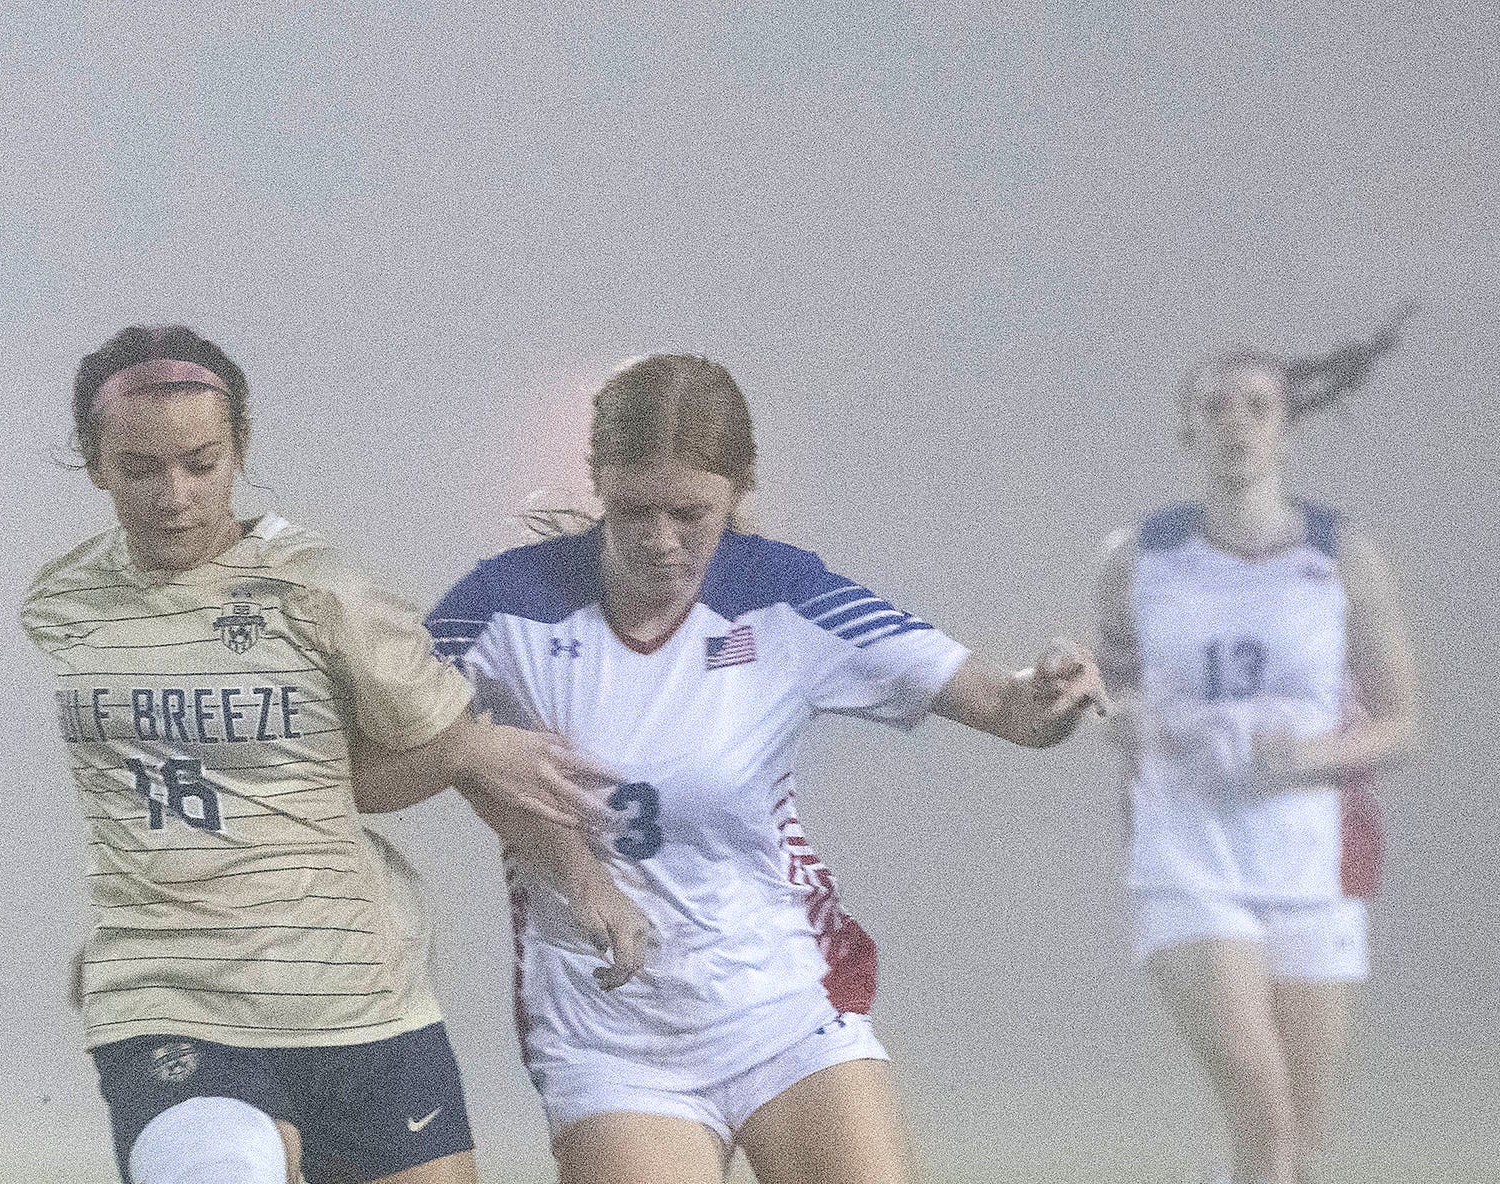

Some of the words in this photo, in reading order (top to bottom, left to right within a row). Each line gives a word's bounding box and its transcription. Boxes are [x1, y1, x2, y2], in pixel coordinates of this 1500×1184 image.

[1201, 635, 1268, 703] 13
[132, 686, 302, 744] BREEZE
[124, 757, 224, 832] 16
[606, 780, 664, 862] 3
